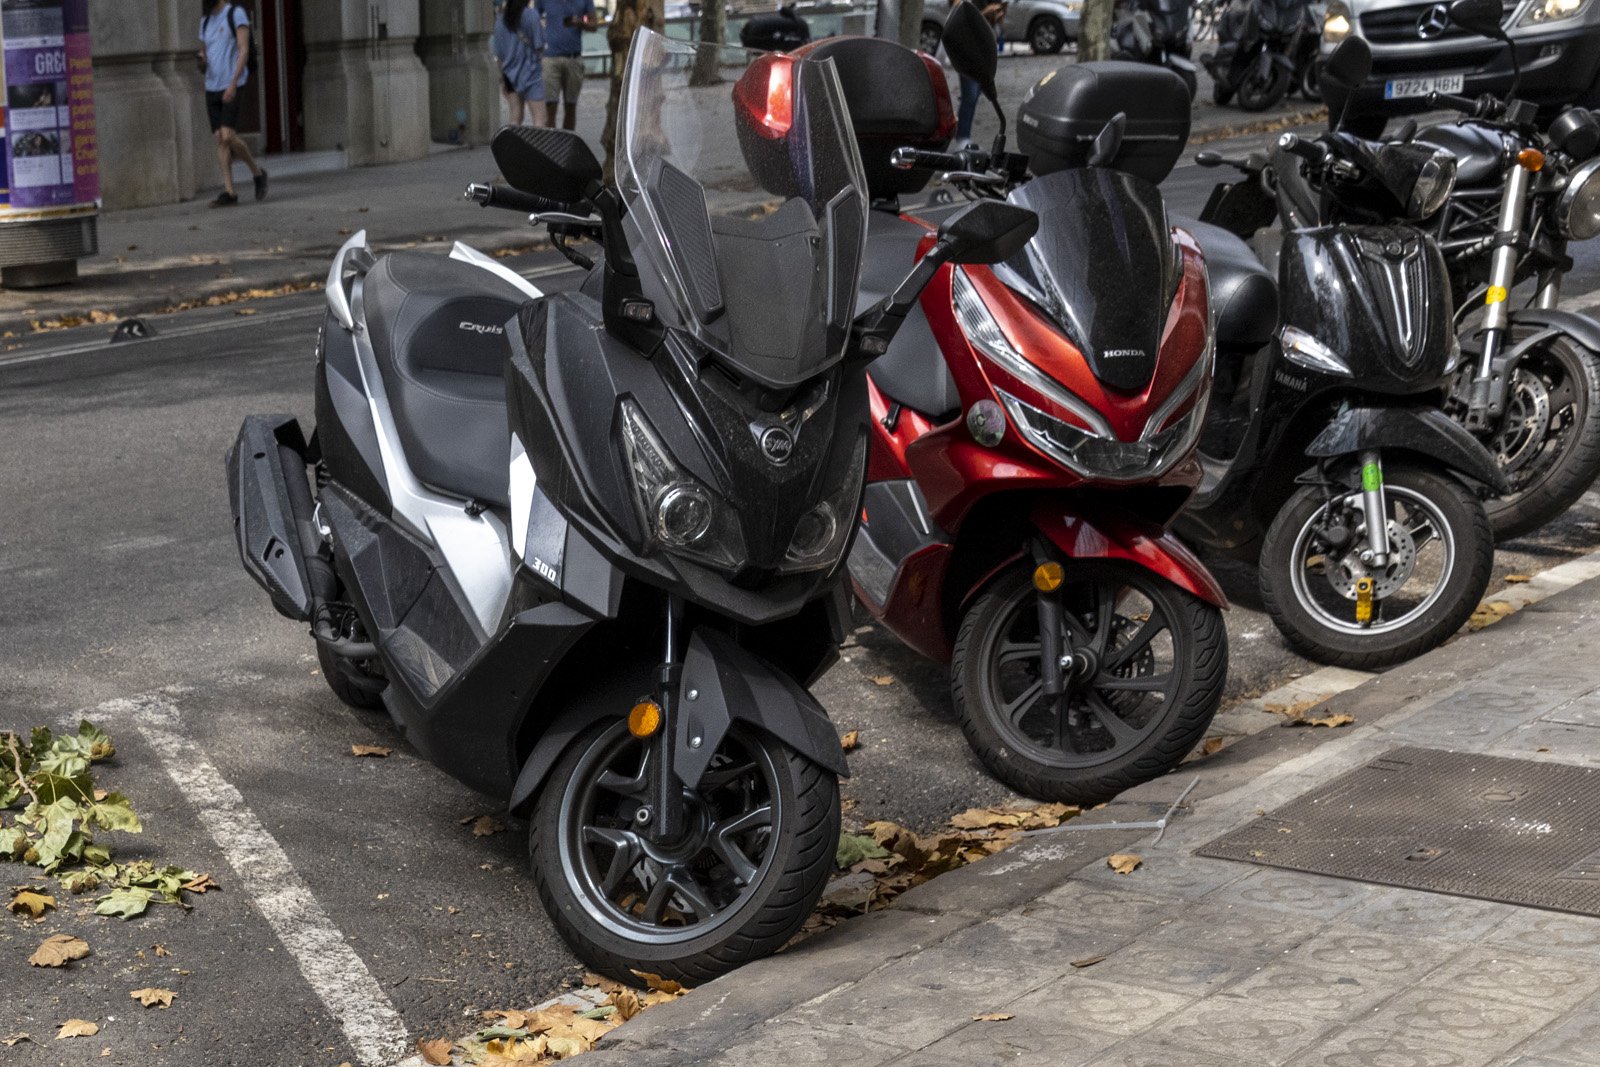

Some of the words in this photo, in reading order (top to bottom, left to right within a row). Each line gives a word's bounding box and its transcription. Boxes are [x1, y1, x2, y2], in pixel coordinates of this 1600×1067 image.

[459, 321, 503, 335] Cruis
[1103, 349, 1146, 358] HONDA
[1275, 369, 1307, 392] YAMAHA
[532, 556, 557, 582] 300
